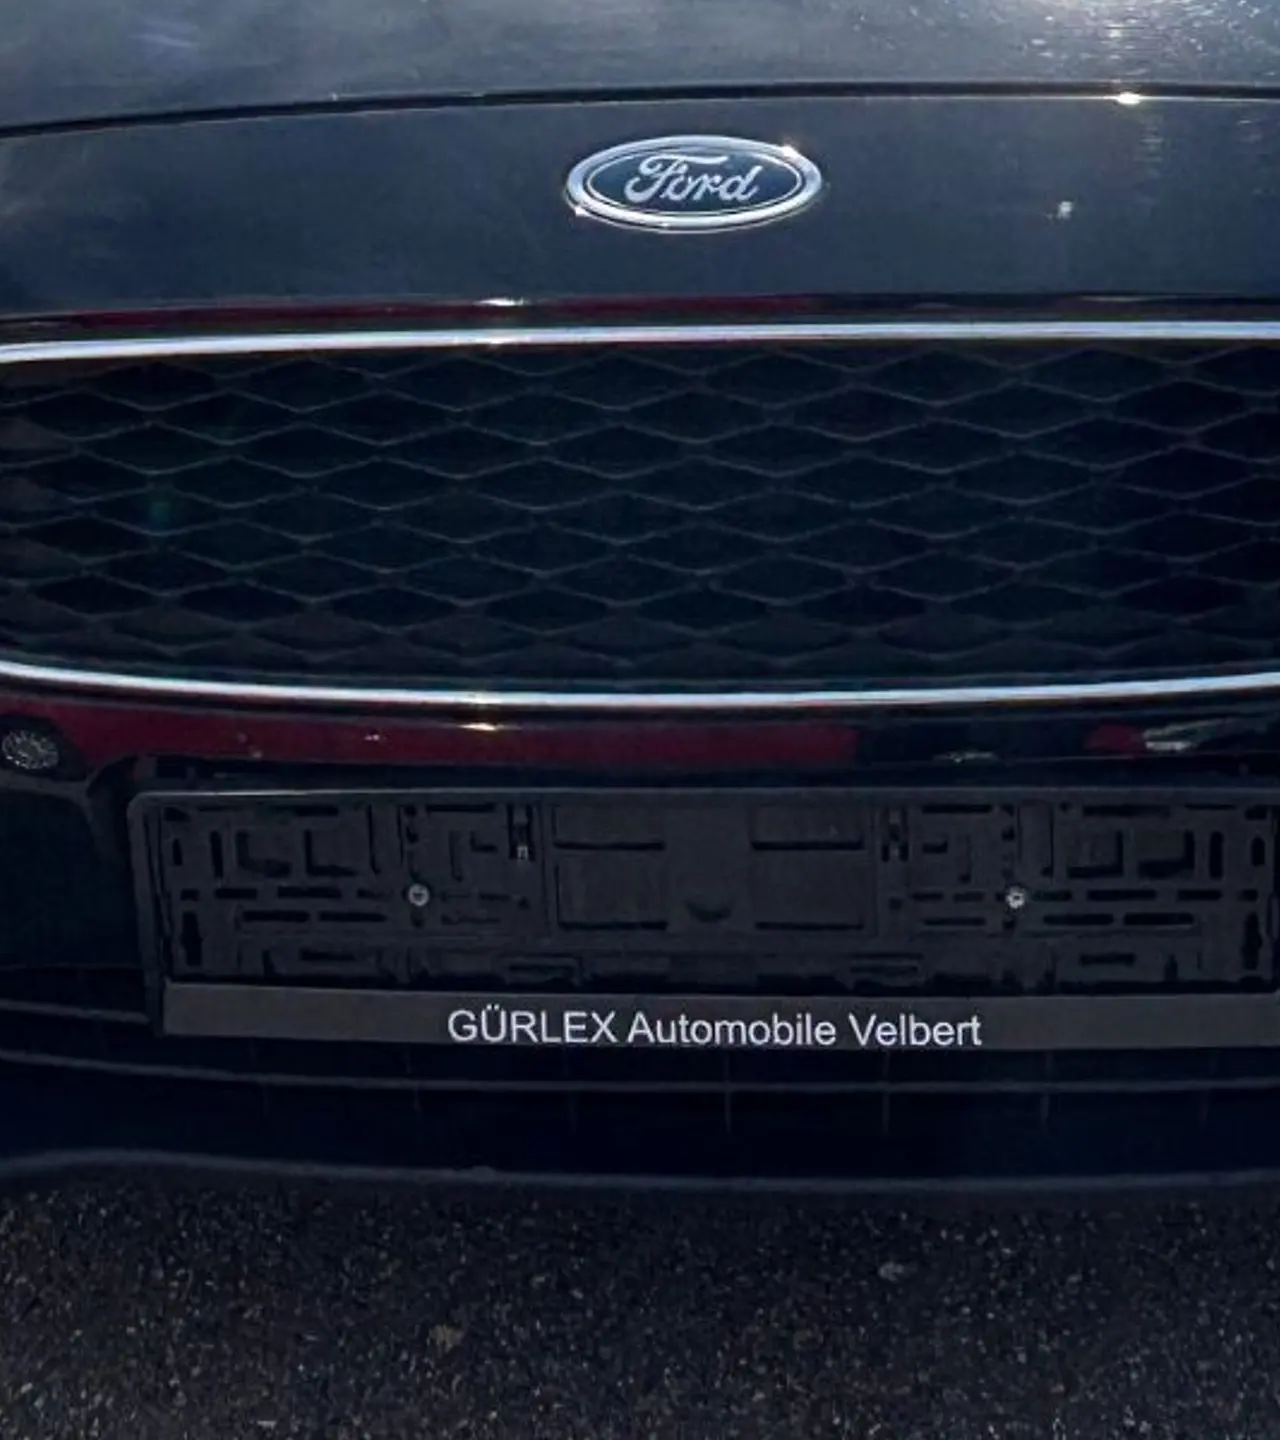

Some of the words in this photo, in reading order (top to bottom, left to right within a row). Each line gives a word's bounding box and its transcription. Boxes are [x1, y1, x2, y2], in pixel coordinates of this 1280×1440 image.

[624, 153, 764, 203] Ford
[447, 1004, 617, 1043] GÜRLEX
[626, 1011, 836, 1046] Automobile
[849, 1013, 982, 1047] Velbert
